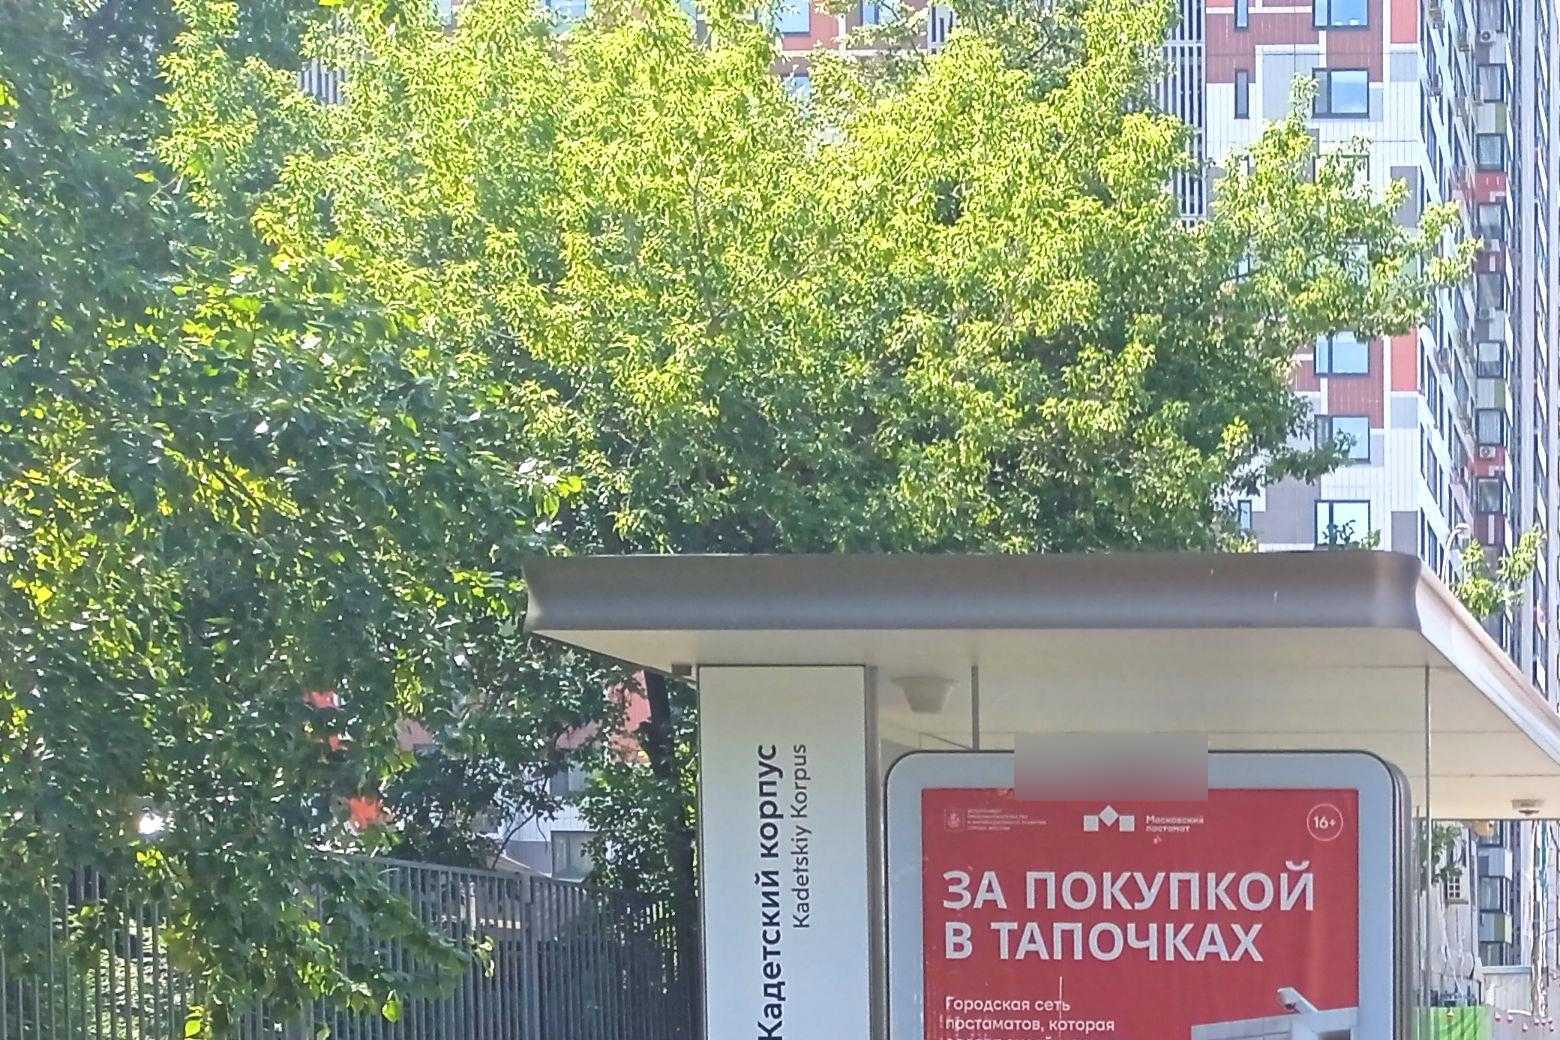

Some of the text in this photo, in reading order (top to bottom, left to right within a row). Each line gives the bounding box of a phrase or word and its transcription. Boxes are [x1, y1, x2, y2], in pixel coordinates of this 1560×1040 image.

[757, 744, 784, 859] корпус
[791, 743, 814, 929] Kadetskiy Korpus
[1314, 814, 1337, 830] 16+
[942, 859, 1314, 911] ЗА ПОКУПКОЙ
[944, 921, 1264, 961] В ТАПОЧКАХ
[945, 997, 1071, 1013] Городская сеть
[945, 1017, 1115, 1034] постаматов, которая
